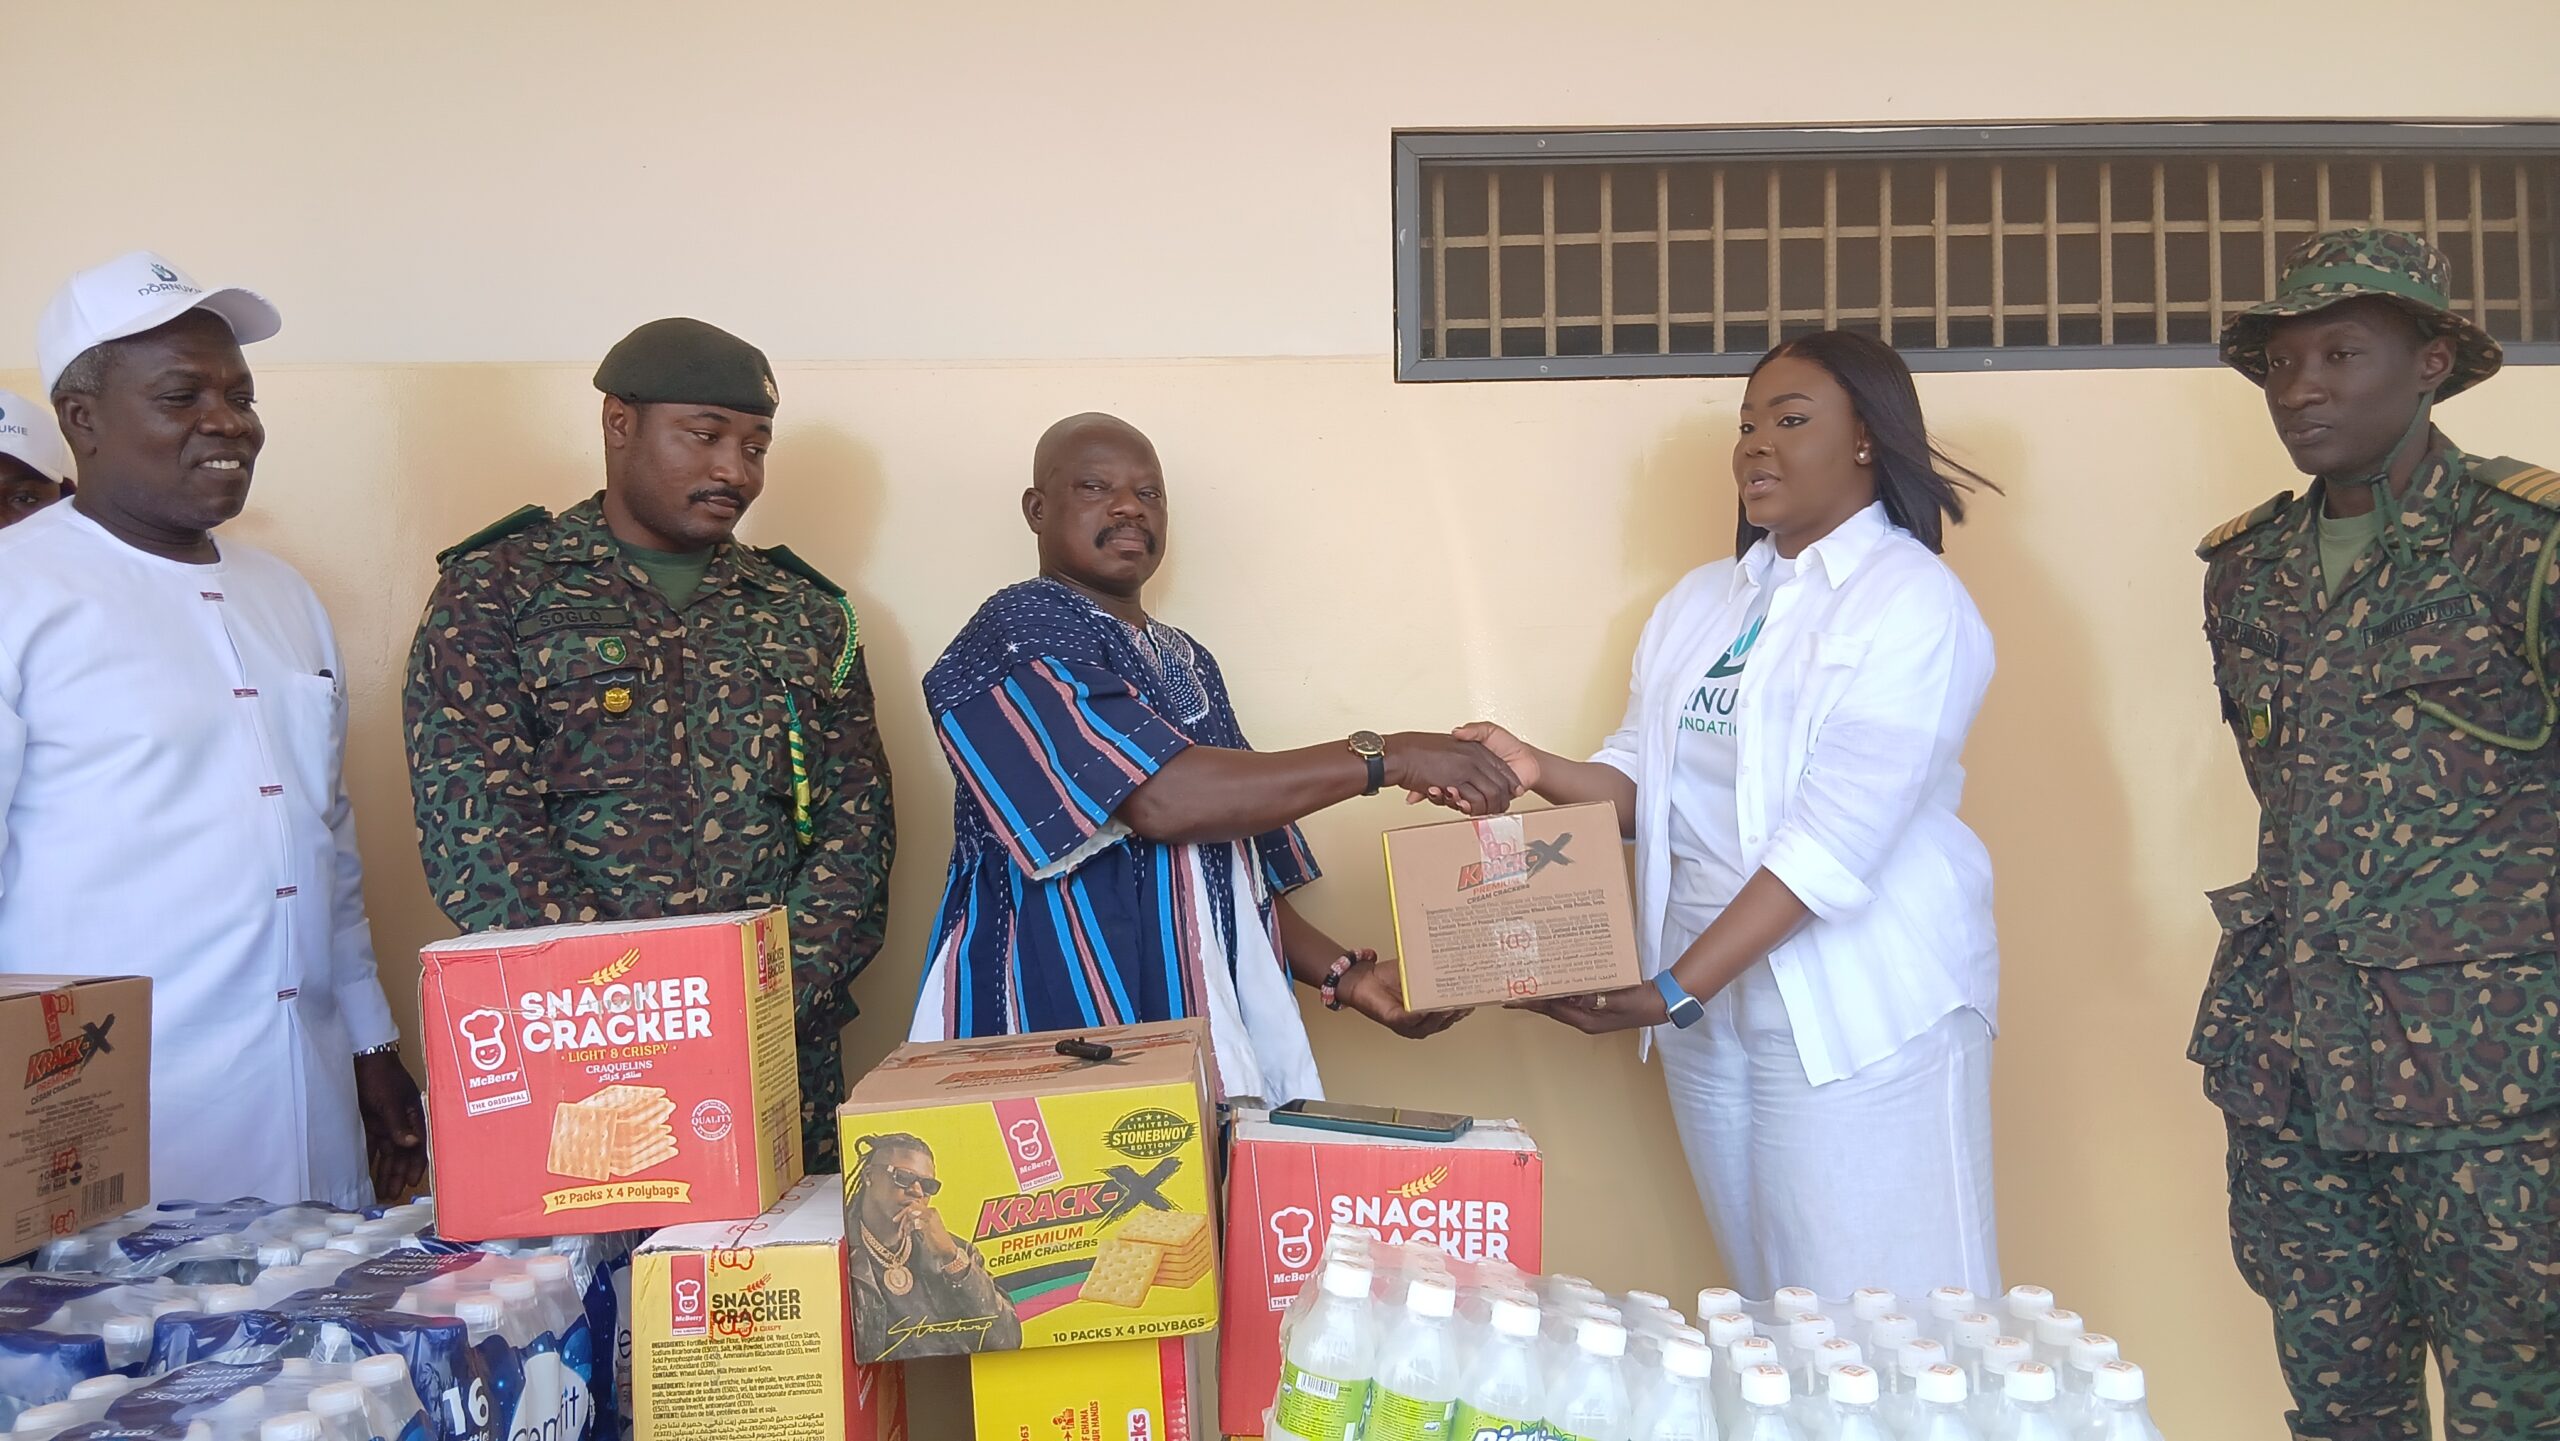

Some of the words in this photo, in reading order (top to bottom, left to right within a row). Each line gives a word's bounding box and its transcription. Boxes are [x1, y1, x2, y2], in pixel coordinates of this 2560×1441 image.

[1467, 892, 1493, 904] CREAM
[520, 977, 710, 1020] SNACKER
[522, 1008, 712, 1052] CRACKER
[568, 1050, 606, 1063] LIGHT
[610, 1049, 619, 1059] &
[622, 1043, 669, 1057] CRISPY
[586, 1060, 653, 1074] CRAQUELINS
[469, 1070, 519, 1089] McBerry
[471, 1102, 486, 1110] THE
[691, 1114, 731, 1127] QUALITY
[1127, 1120, 1170, 1130] LIMITED
[1112, 1125, 1189, 1146] STONEBWOY
[1130, 1142, 1171, 1151] EDITION
[553, 1194, 566, 1205] 12
[570, 1190, 603, 1204] Packs
[606, 1188, 614, 1198] X
[617, 1187, 624, 1198] 4
[628, 1185, 680, 1199] Polybags
[1331, 1195, 1509, 1231] SNACKER
[1001, 1226, 1084, 1254] PREMIUM
[988, 1251, 1032, 1268] CREAM
[1034, 1238, 1098, 1258] CRACKERS
[712, 1289, 801, 1309] SNACKER
[713, 1305, 801, 1323] CRACKER
[1053, 1332, 1068, 1343] 10
[1071, 1327, 1112, 1341] PACKS
[1115, 1327, 1125, 1337] X
[1127, 1325, 1136, 1336] 4
[1138, 1317, 1205, 1334] POLYBAGS
[442, 1377, 490, 1436] 16
[1090, 1401, 1099, 1427] HANDS
[1080, 1409, 1089, 1435] GHANA
